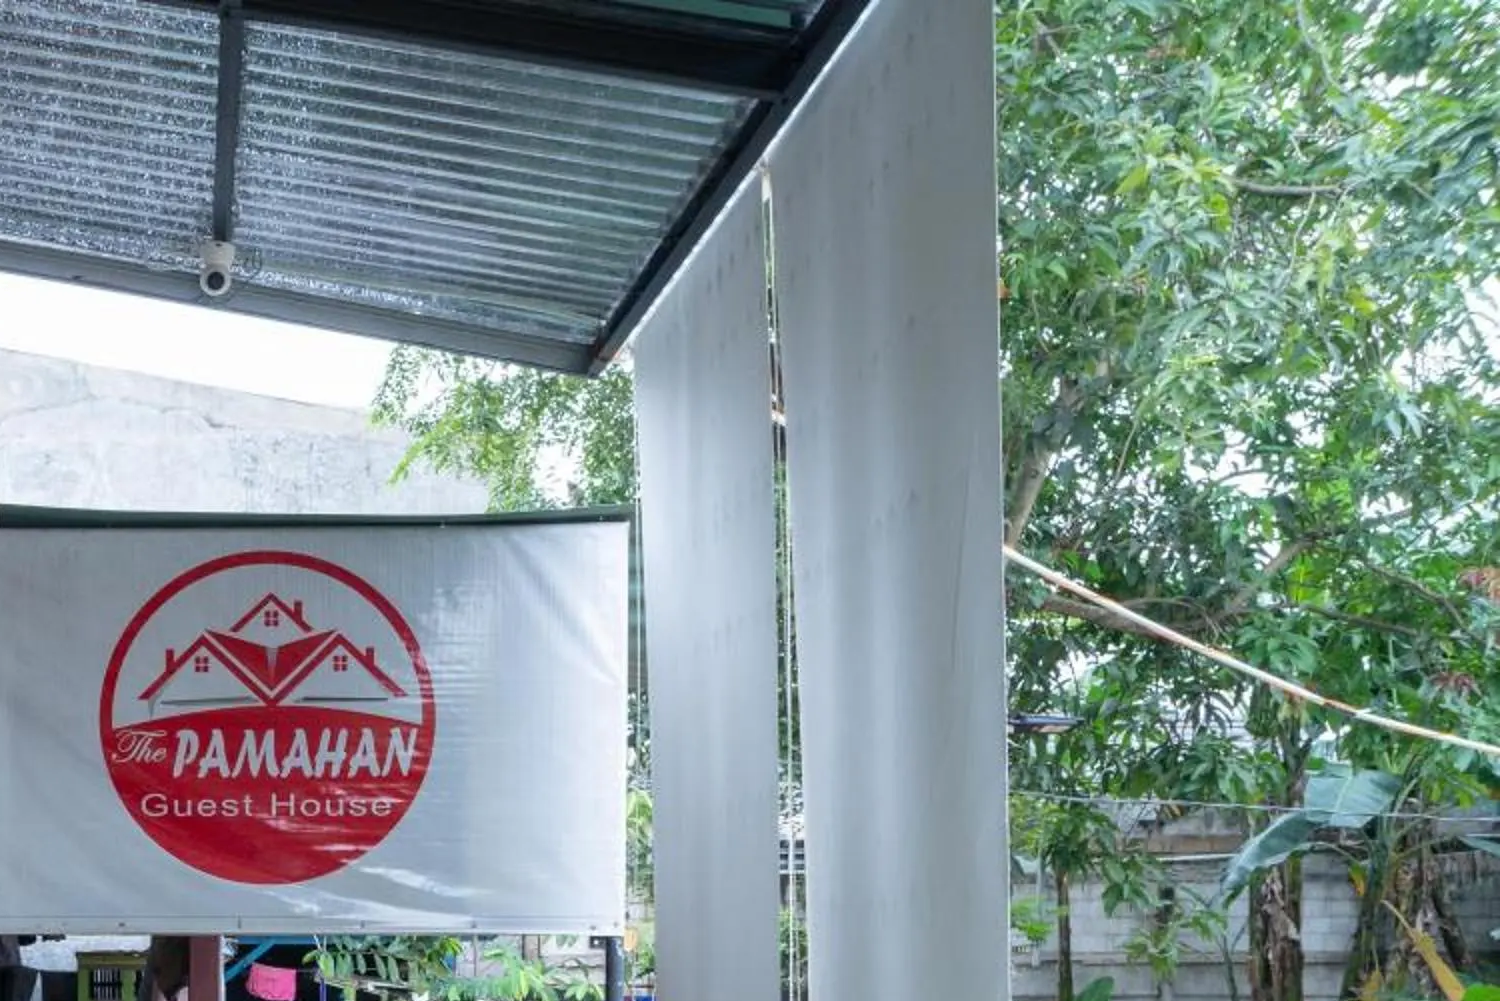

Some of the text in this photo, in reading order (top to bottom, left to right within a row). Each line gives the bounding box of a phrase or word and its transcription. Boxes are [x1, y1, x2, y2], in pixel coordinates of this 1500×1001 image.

[112, 727, 419, 778] The PAMAHAN
[140, 791, 393, 817] Guest House
